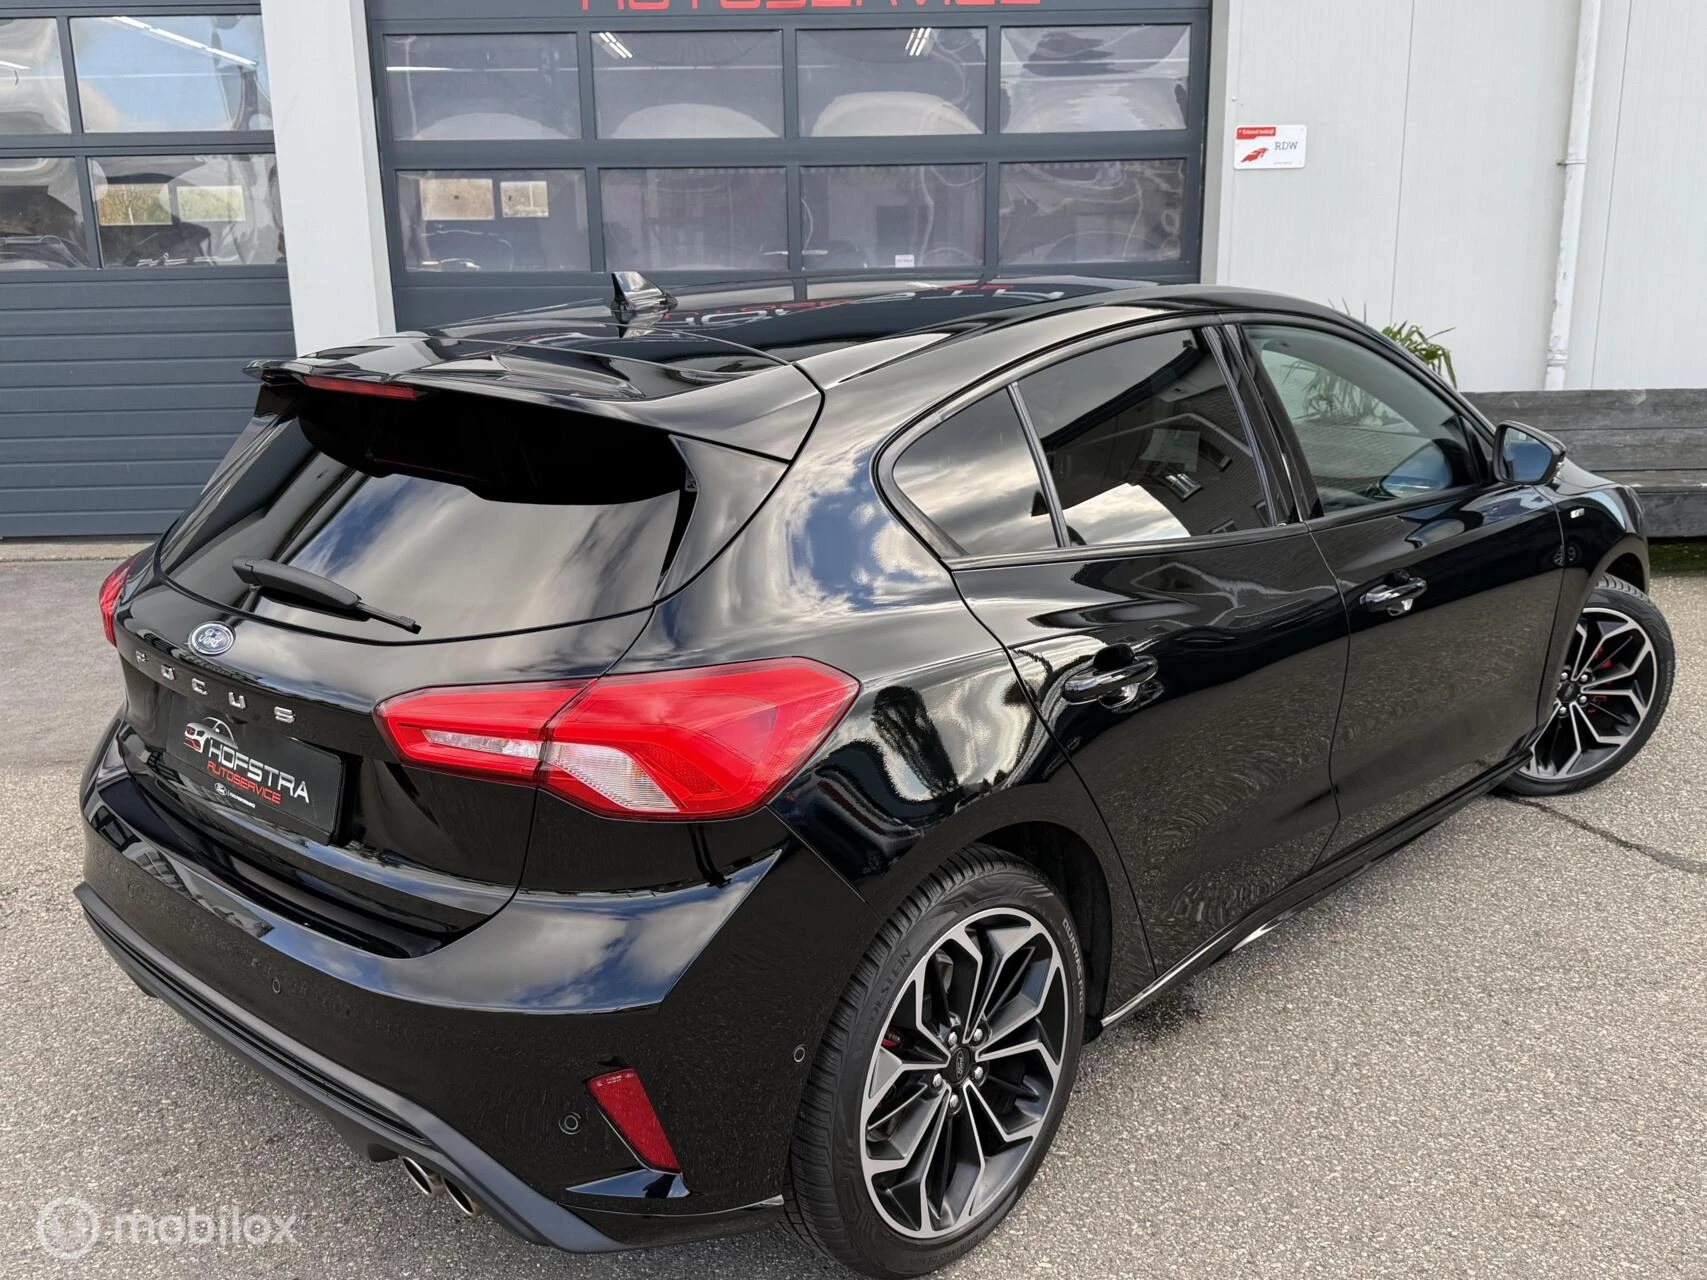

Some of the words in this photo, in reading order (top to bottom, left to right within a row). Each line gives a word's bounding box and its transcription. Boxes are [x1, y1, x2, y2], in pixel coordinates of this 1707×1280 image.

[1275, 141, 1298, 151] RDW
[198, 628, 225, 649] Ford
[135, 650, 296, 724] FOCUS
[206, 760, 283, 805] AUTOSERVICE
[208, 739, 310, 804] HOFSTRA
